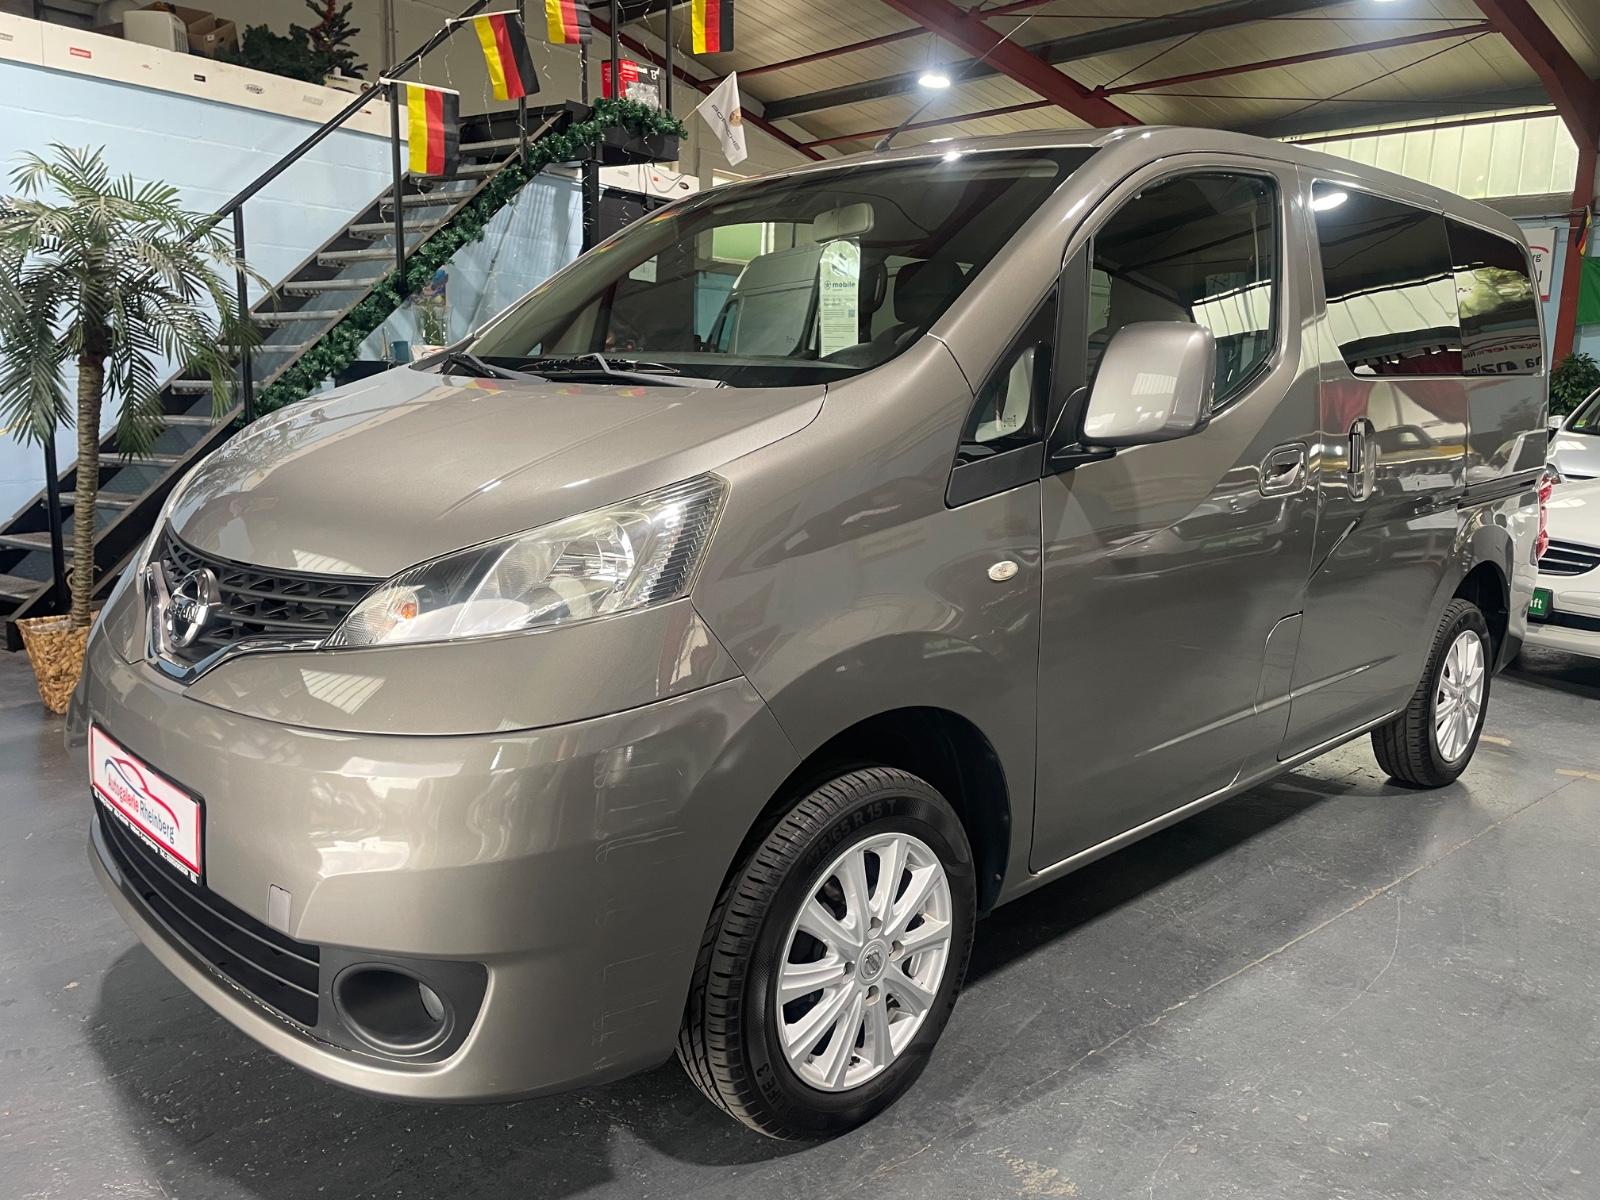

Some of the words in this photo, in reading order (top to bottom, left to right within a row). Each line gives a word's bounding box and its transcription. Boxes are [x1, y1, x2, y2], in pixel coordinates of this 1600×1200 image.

[711, 104, 741, 151] PORCHE
[108, 772, 139, 813] Autogalerie
[139, 800, 175, 845] Rheinberg
[853, 812, 865, 828] R
[867, 803, 883, 820] 15
